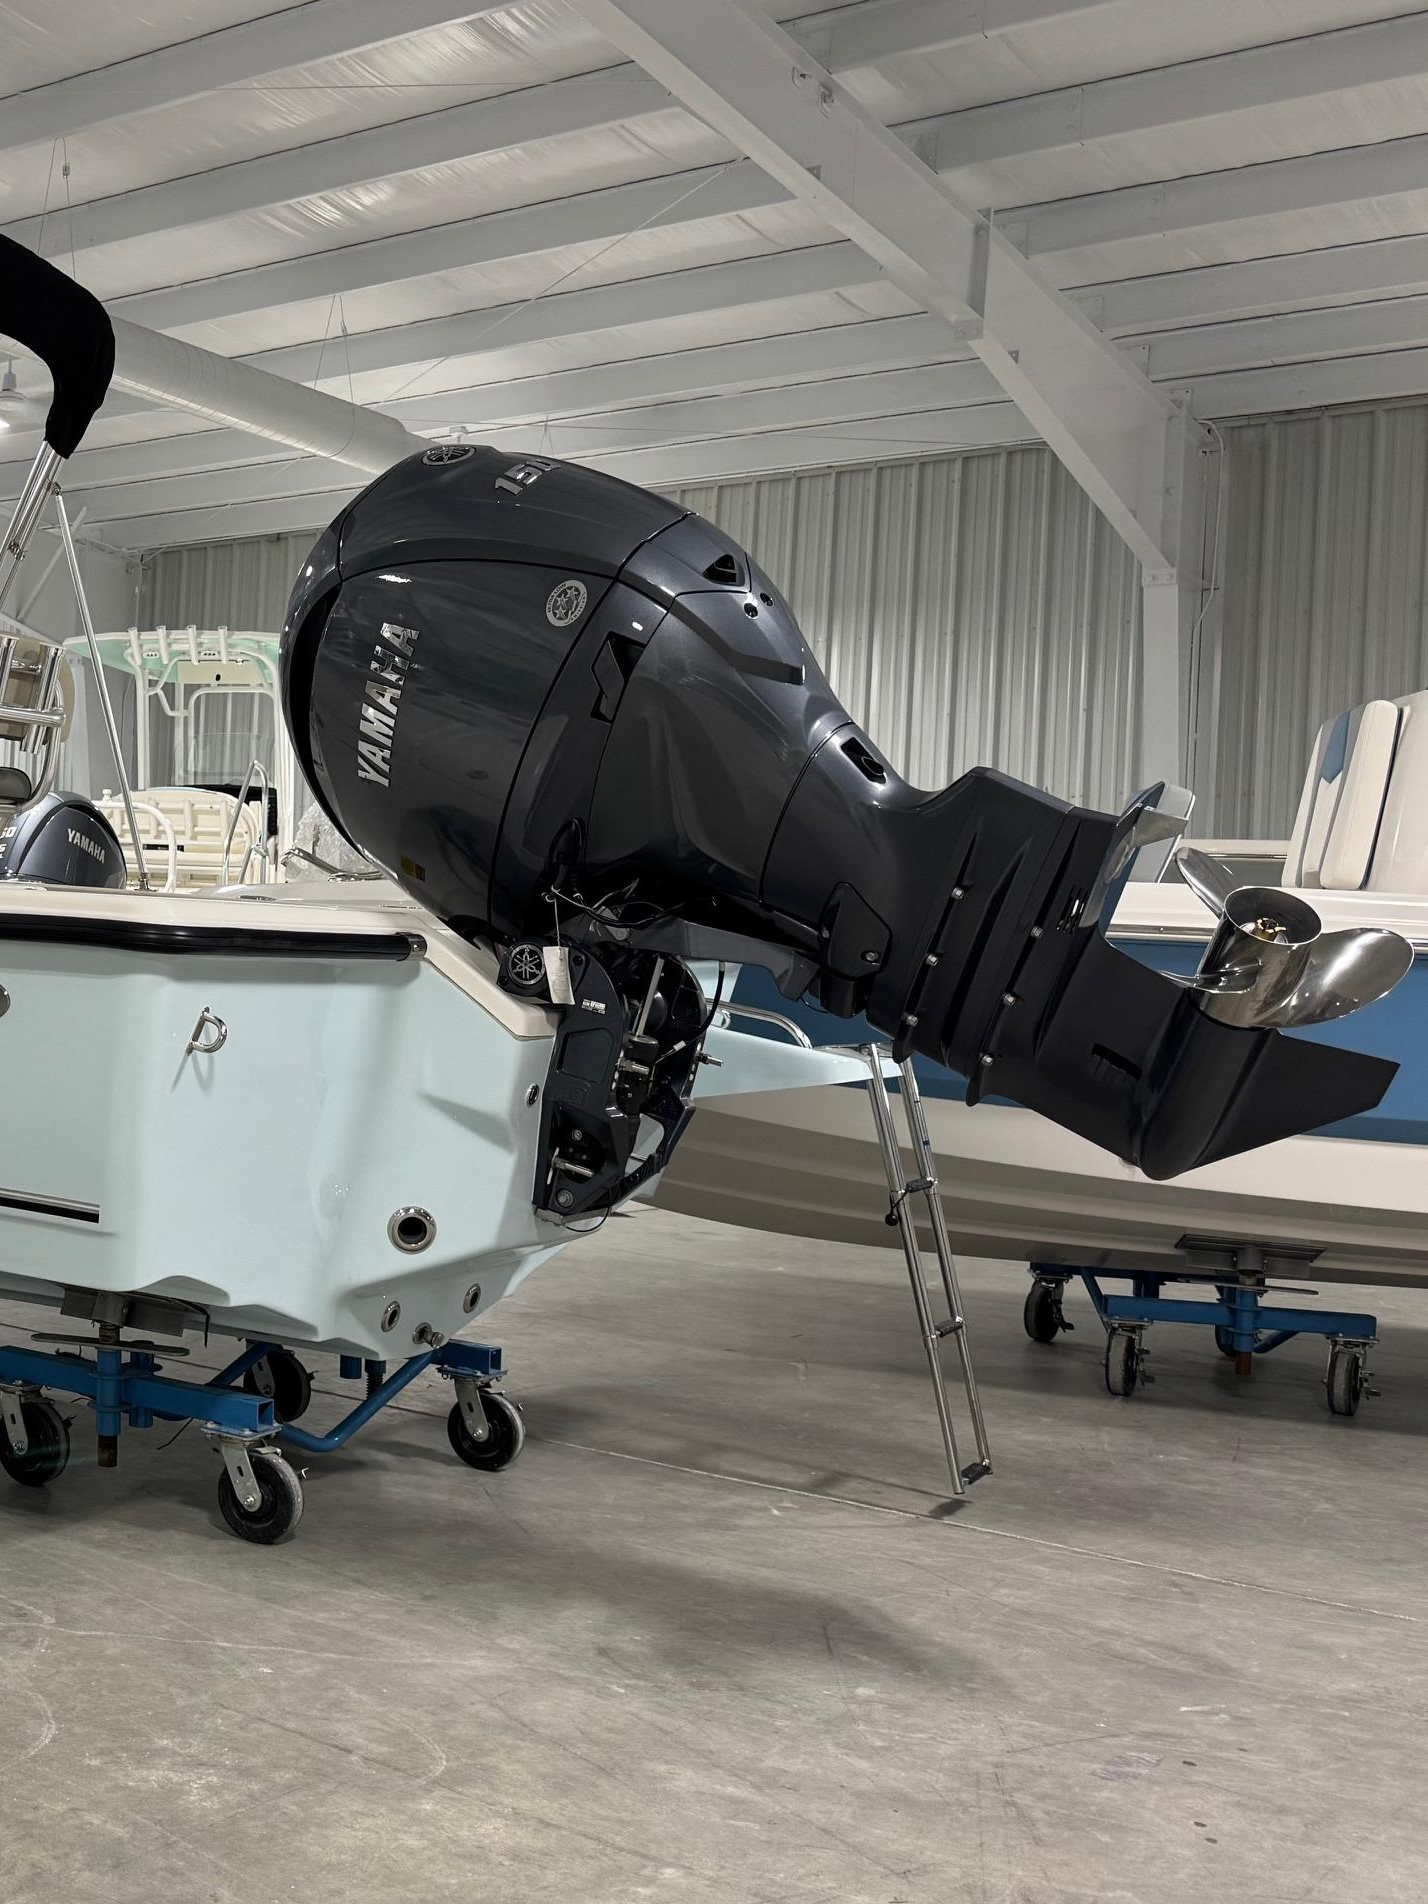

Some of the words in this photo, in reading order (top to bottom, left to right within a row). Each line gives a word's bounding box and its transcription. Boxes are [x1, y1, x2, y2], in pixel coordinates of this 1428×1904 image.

[494, 459, 562, 495] 150
[357, 622, 420, 788] YAMAHA
[67, 828, 106, 864] YAMAHA
